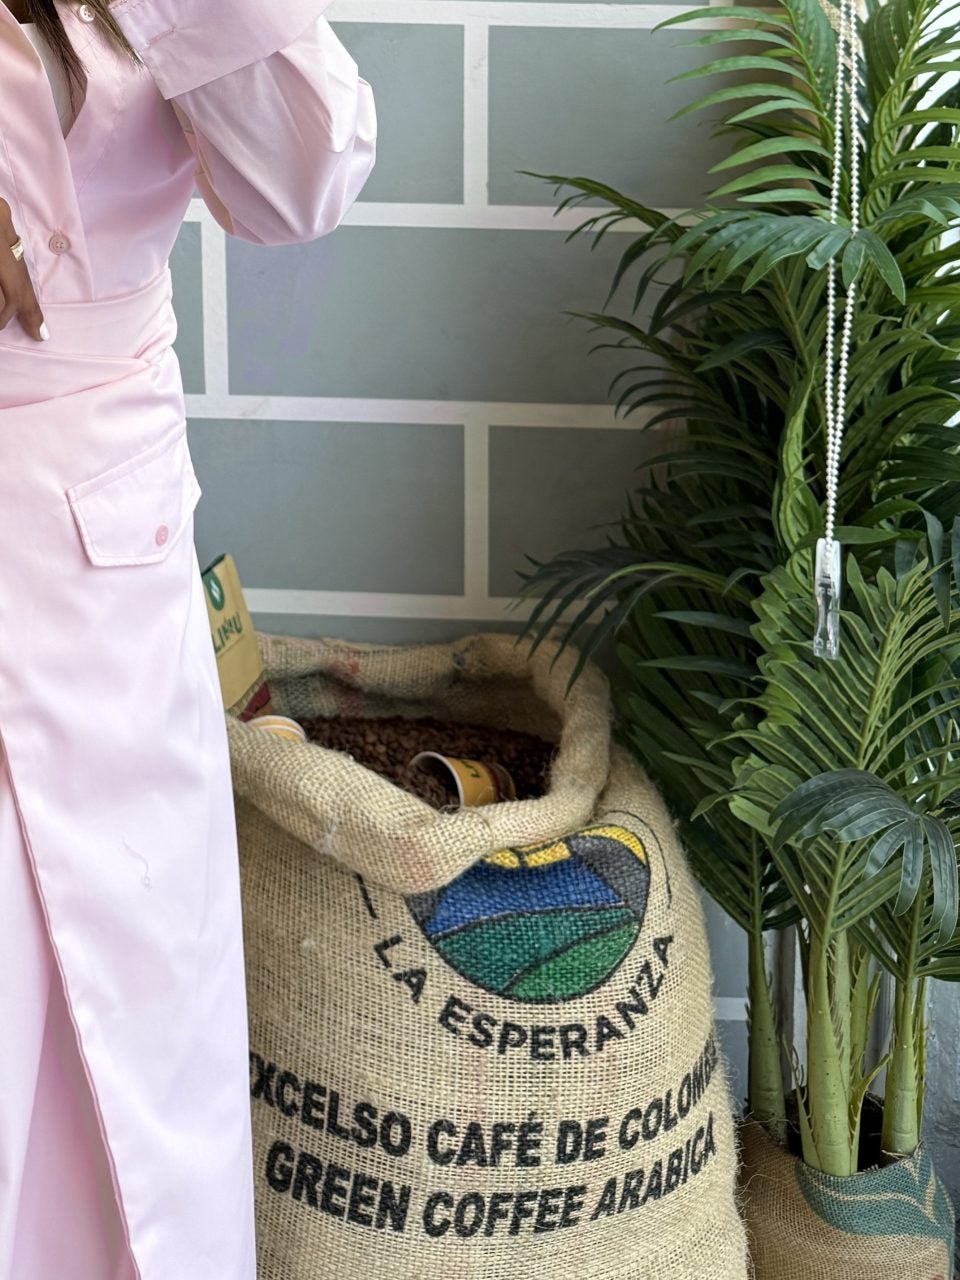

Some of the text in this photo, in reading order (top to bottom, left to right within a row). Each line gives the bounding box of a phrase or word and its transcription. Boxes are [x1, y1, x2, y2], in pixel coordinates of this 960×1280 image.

[374, 934, 674, 1061] LA ESPERANZA
[250, 1052, 411, 1157] XCELSO
[426, 1111, 541, 1167] CAFÉ
[555, 1116, 609, 1165] DE
[265, 1112, 716, 1237] GREEN COFFEE ARABICA
